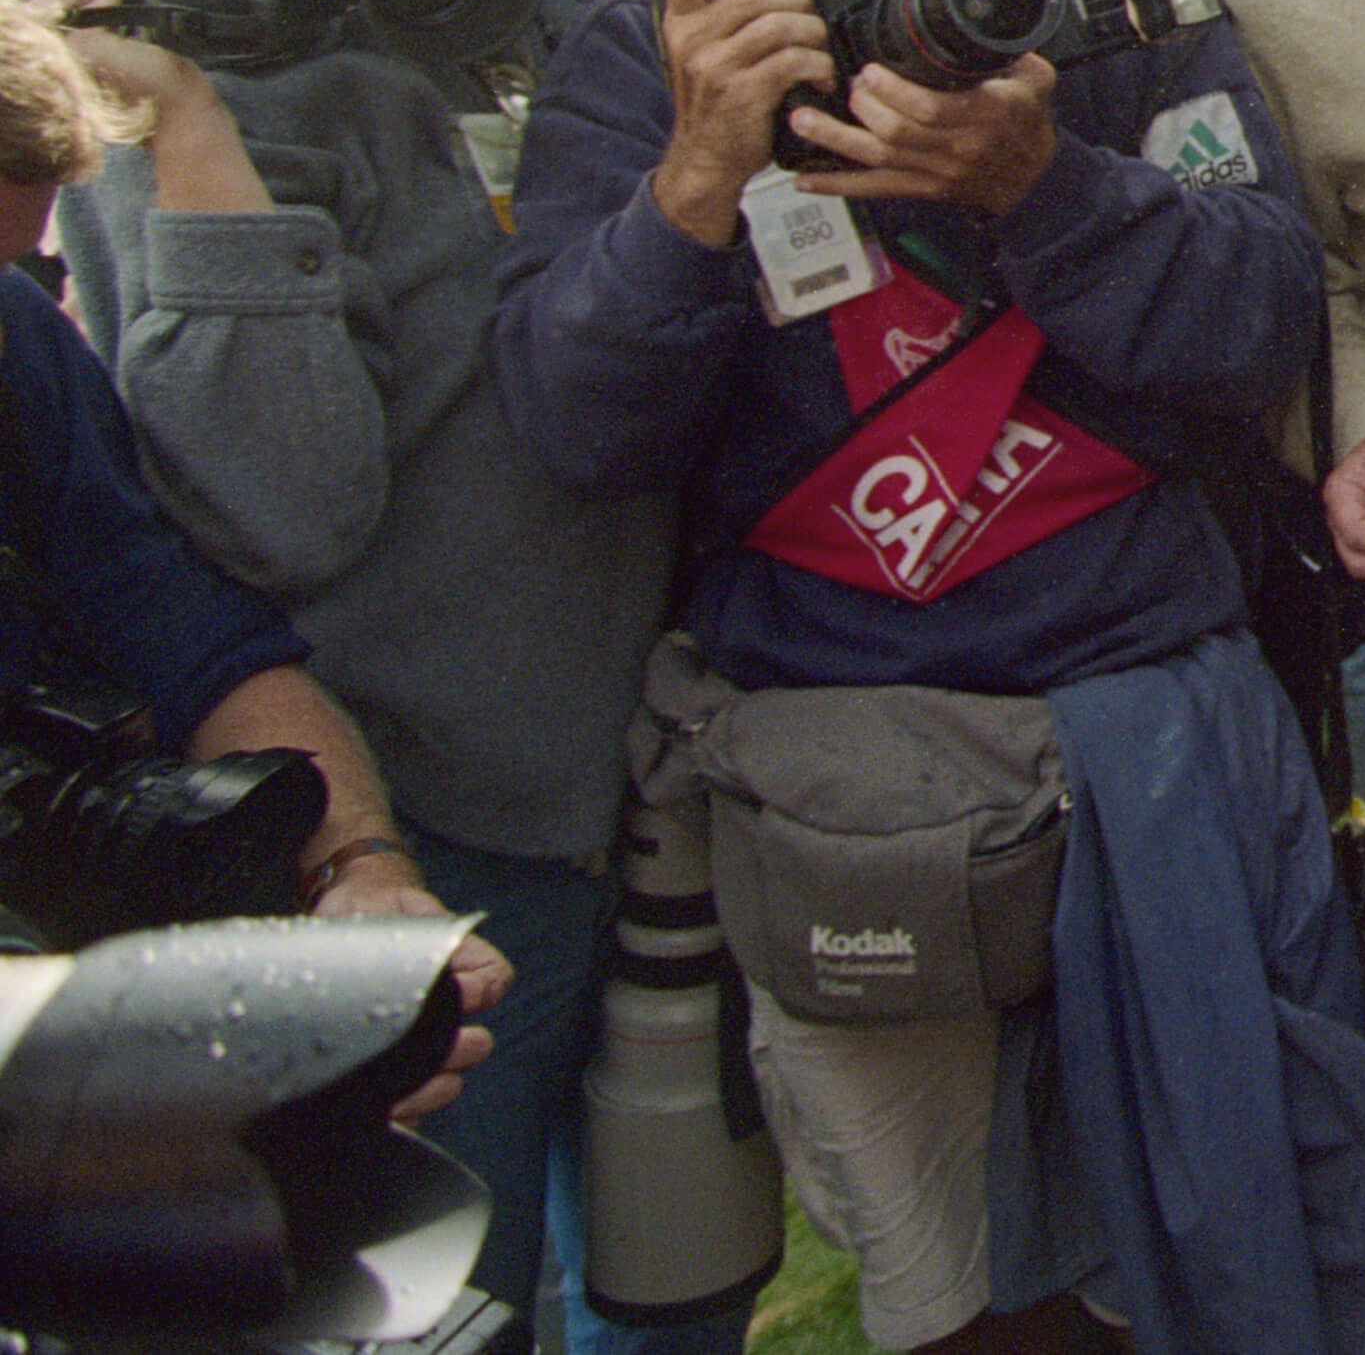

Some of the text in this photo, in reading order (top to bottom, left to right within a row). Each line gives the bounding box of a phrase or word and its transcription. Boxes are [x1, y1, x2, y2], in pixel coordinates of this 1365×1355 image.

[1181, 150, 1248, 191] didas
[789, 220, 833, 250] 690
[811, 925, 917, 956] Kodak
